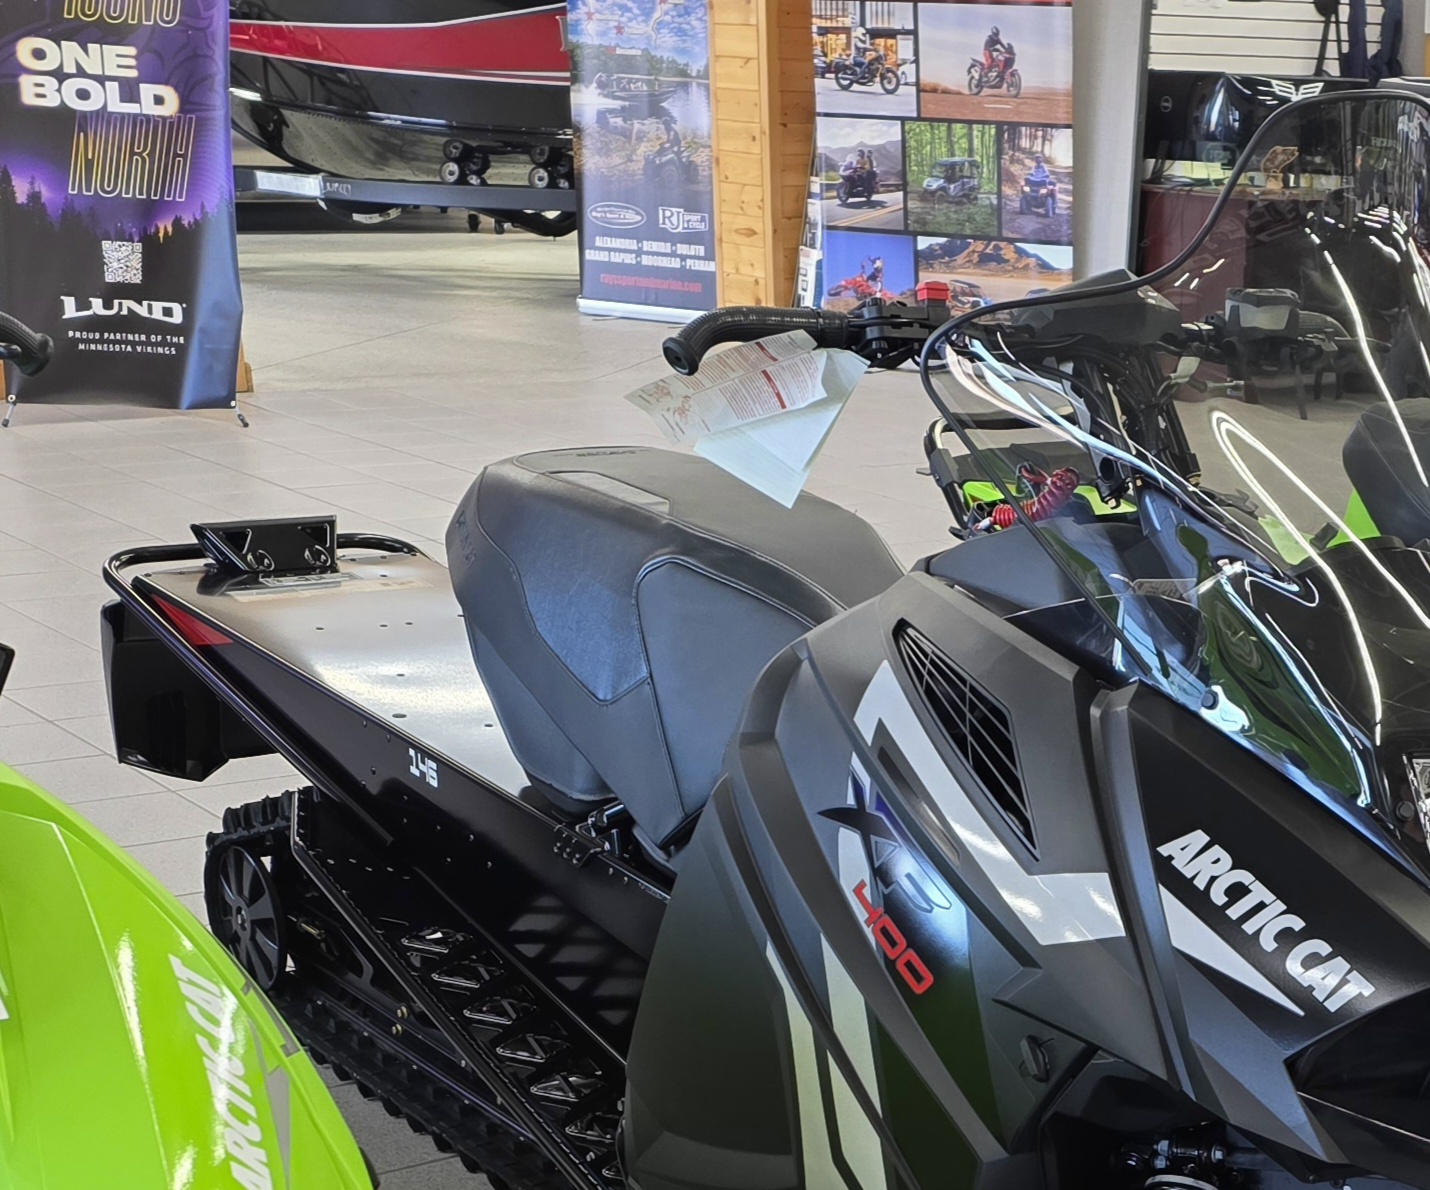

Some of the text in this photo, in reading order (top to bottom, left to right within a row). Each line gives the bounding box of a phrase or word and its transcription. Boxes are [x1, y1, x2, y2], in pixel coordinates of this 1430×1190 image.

[16, 36, 139, 78] ONE
[18, 74, 181, 116] BOLD
[68, 112, 196, 202] NORTH
[60, 295, 183, 324] LUND
[68, 330, 185, 344] PROUD PARTNER OF THE
[78, 342, 176, 355] MINNESOTA VIKINGS
[408, 747, 438, 788] 146
[852, 878, 935, 996] 400
[1156, 828, 1377, 1013] ARCTIC CAT
[168, 953, 237, 1044] CAT
